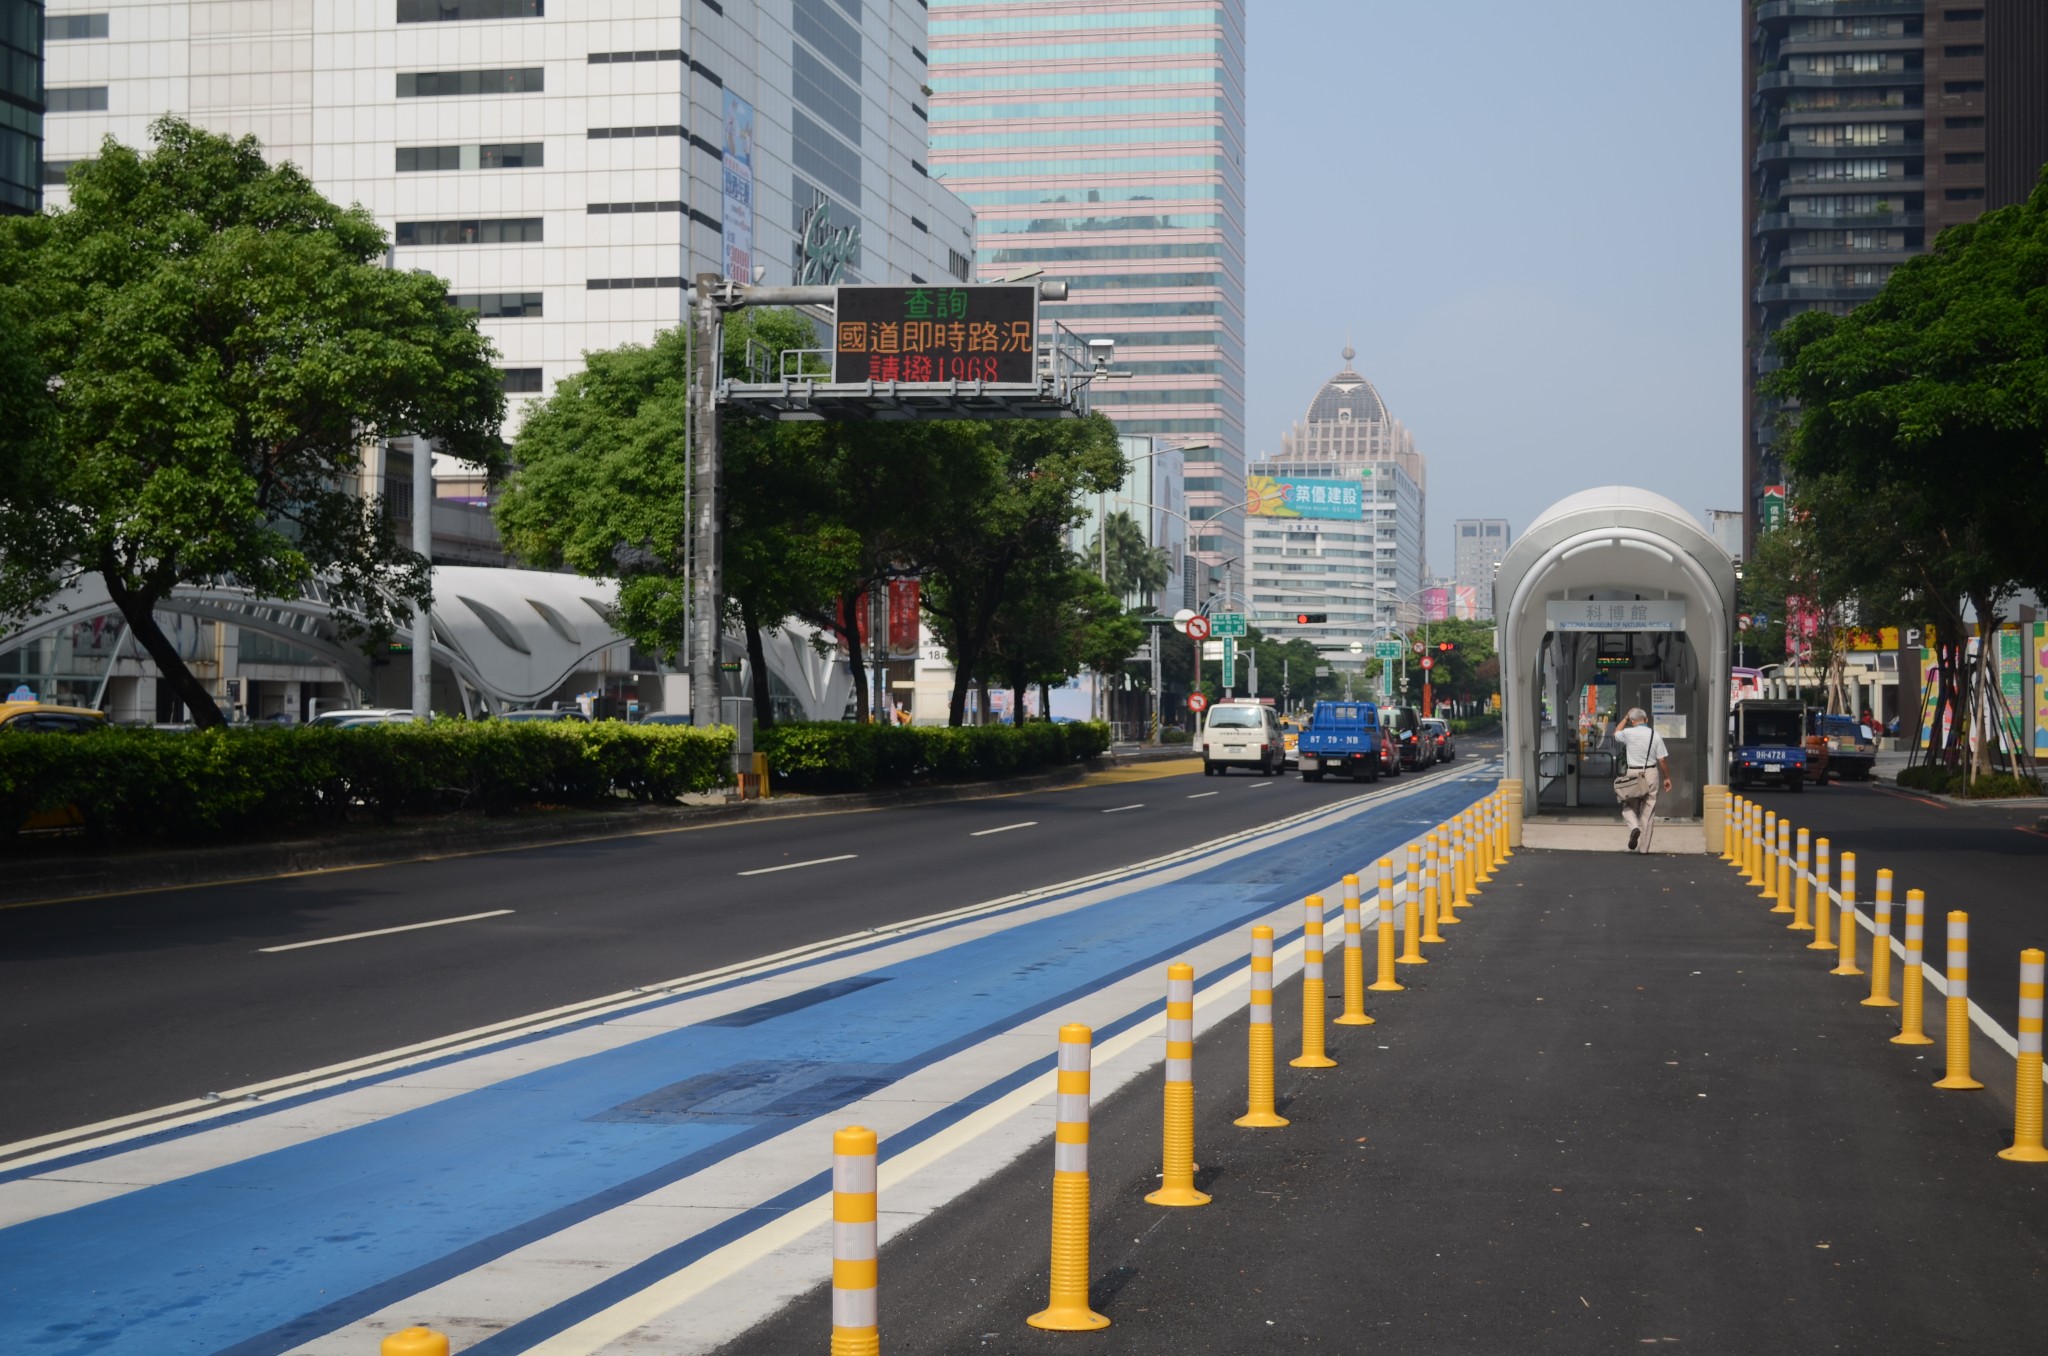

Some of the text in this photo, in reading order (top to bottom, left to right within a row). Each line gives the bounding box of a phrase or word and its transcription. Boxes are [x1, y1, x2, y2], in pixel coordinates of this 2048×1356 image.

[904, 288, 968, 319] 查詢
[838, 321, 1032, 353] 國道即時路況
[869, 355, 998, 382] 請撥1968
[1296, 485, 1357, 505] 築優建設
[1586, 605, 1648, 621] 科博館
[1907, 629, 1920, 645] P
